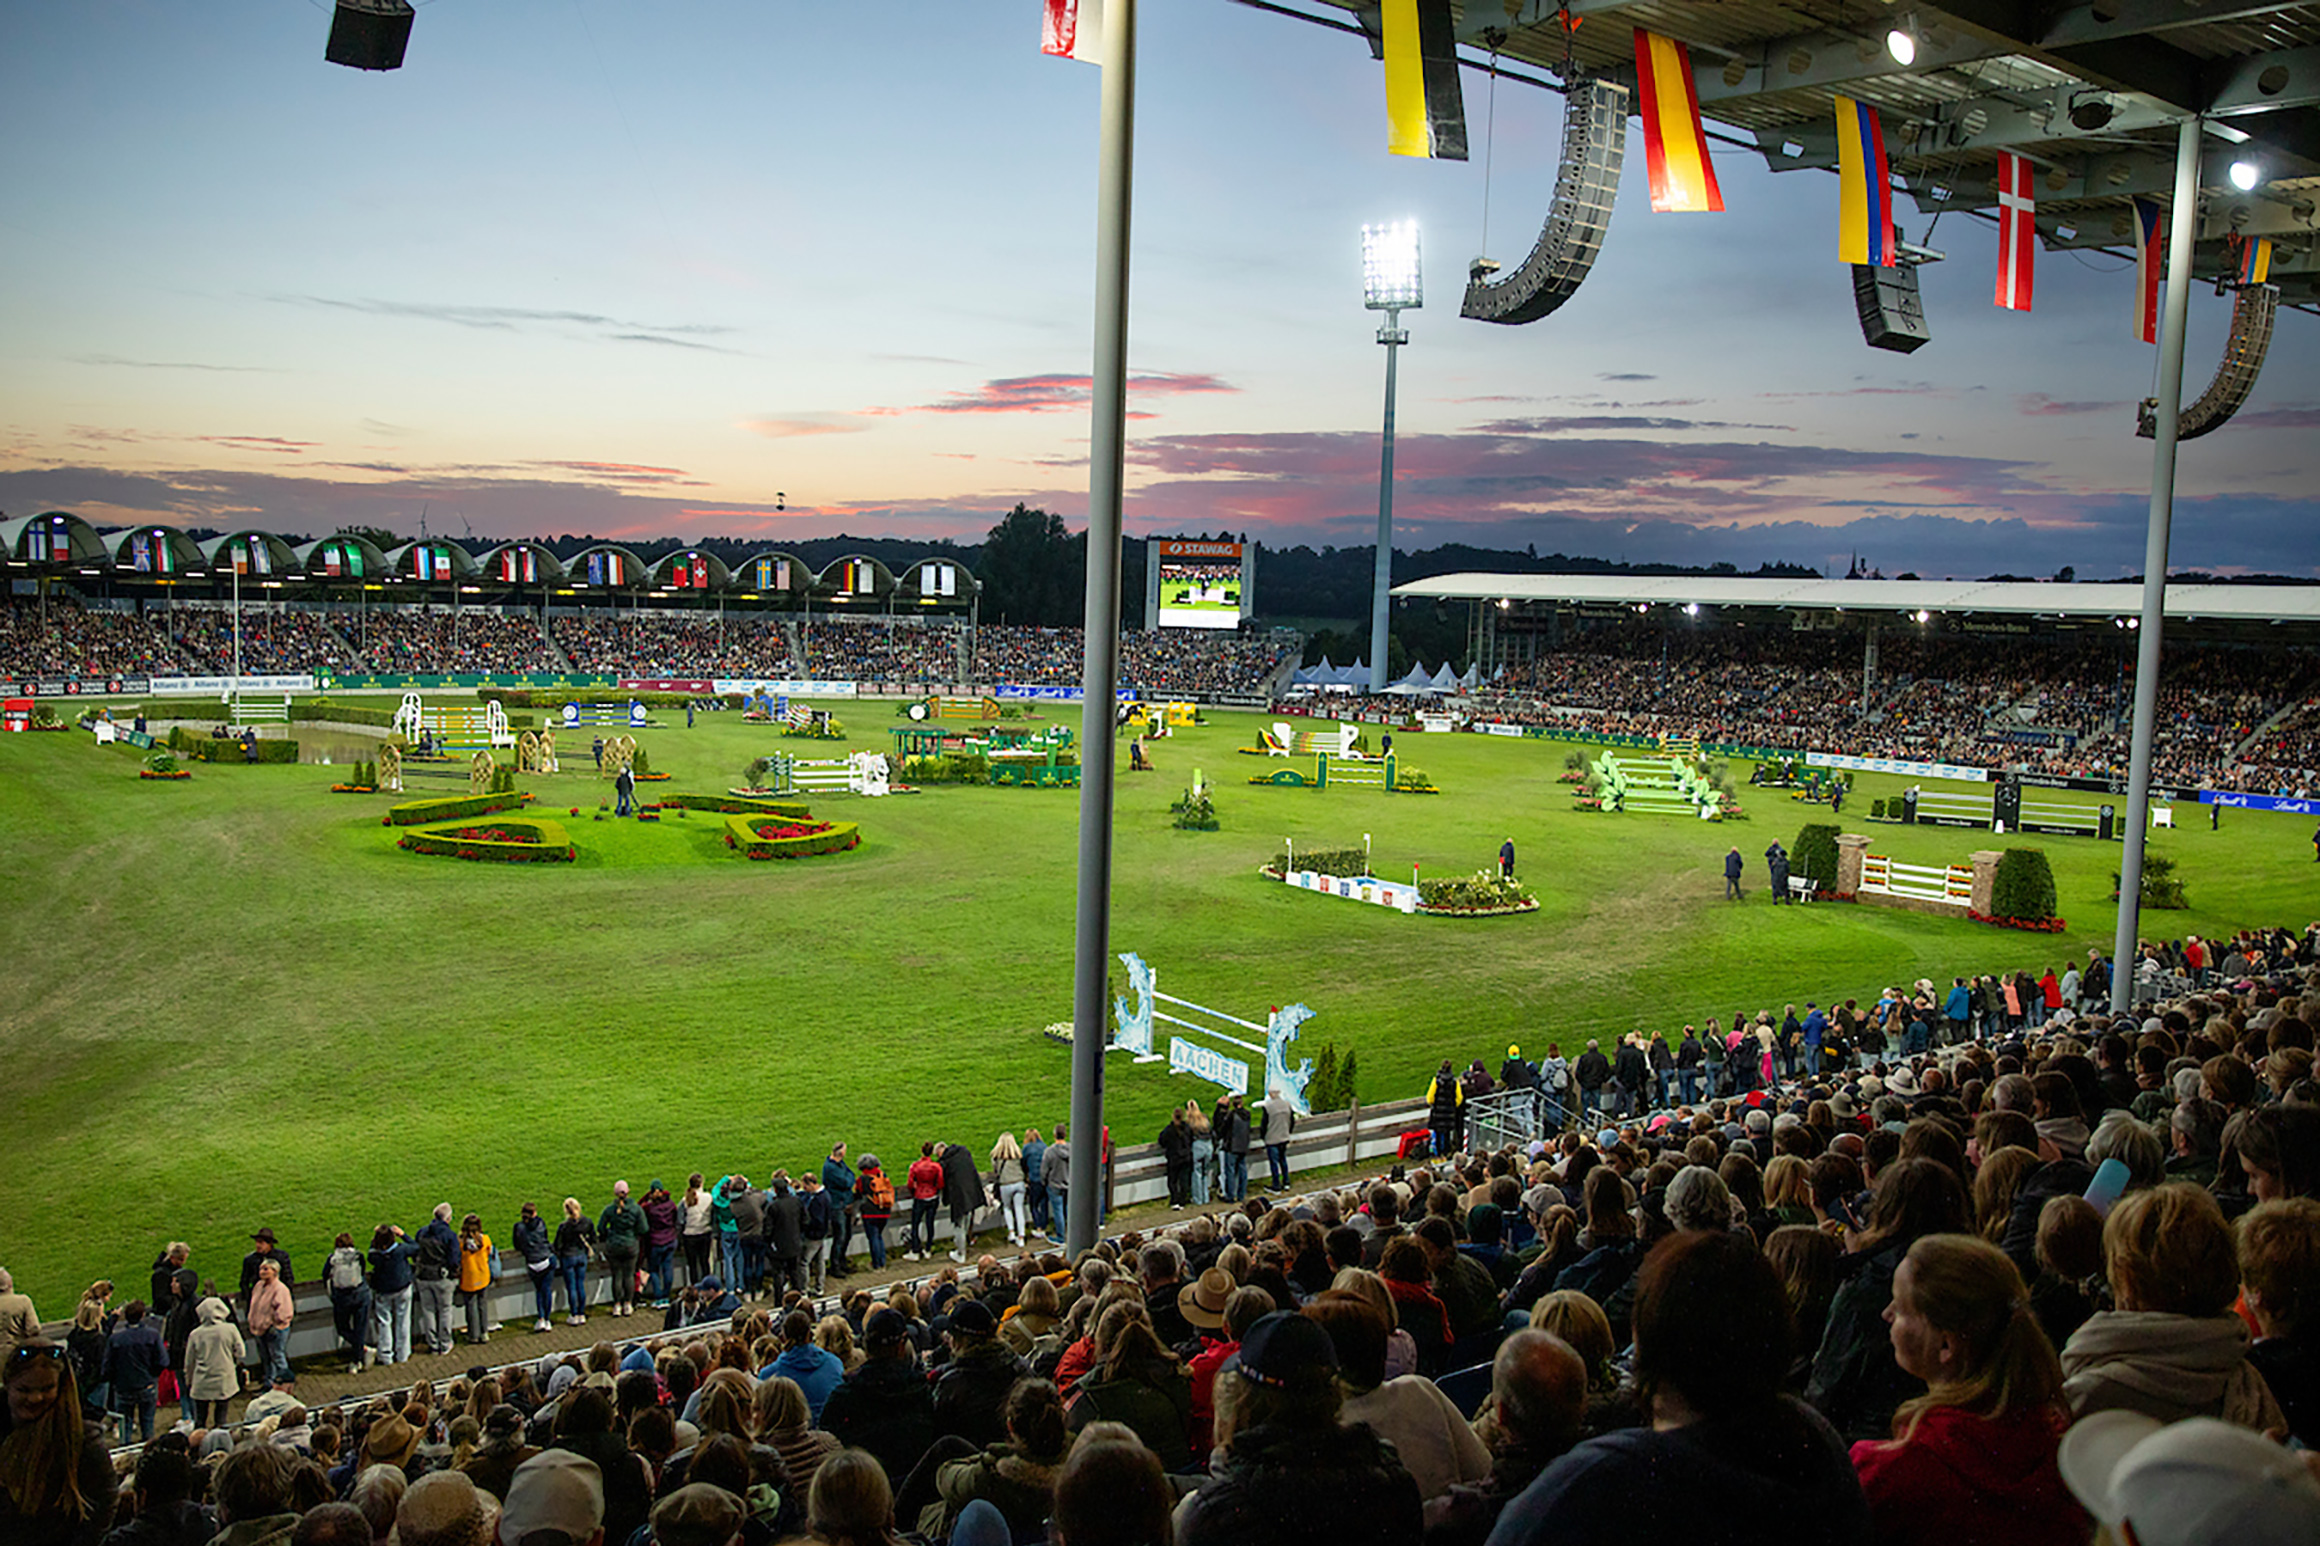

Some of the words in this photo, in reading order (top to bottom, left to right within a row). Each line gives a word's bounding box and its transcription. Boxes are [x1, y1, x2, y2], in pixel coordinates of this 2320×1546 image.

[1184, 543, 1233, 555] STAWAG
[1962, 621, 2031, 633] Mercedes-Benz
[2018, 775, 2068, 788] Mercedes-Benz
[1174, 1045, 1243, 1086] AACHEN
